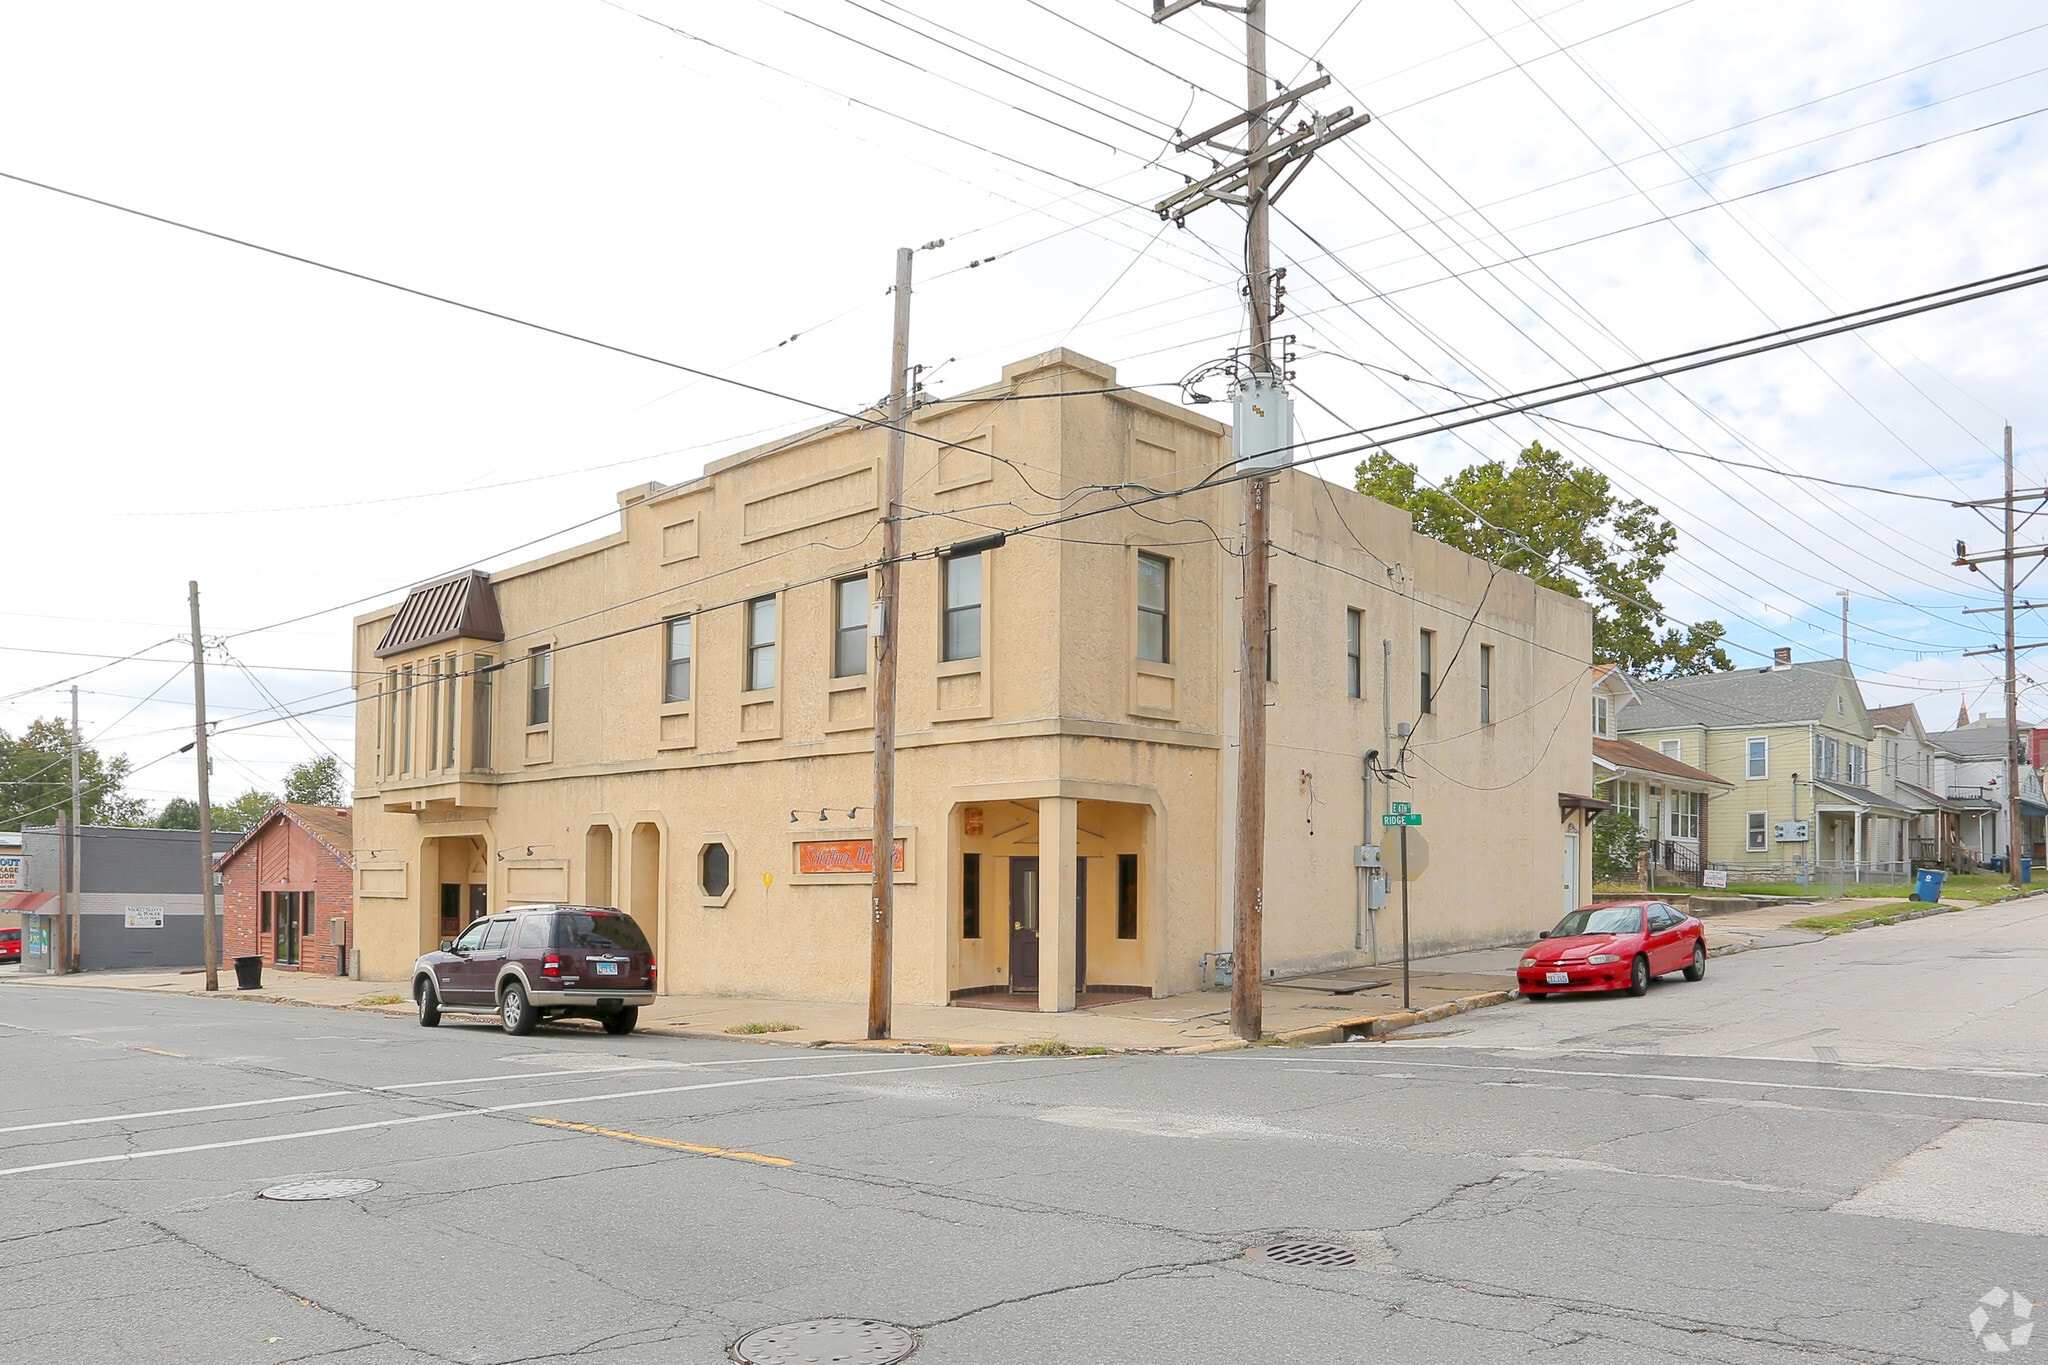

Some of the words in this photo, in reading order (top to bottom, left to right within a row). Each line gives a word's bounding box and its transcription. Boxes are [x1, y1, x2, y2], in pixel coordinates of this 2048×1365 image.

[1393, 803, 1397, 812] E
[1384, 816, 1407, 825] RIDGE
[0, 858, 21, 866] OUT
